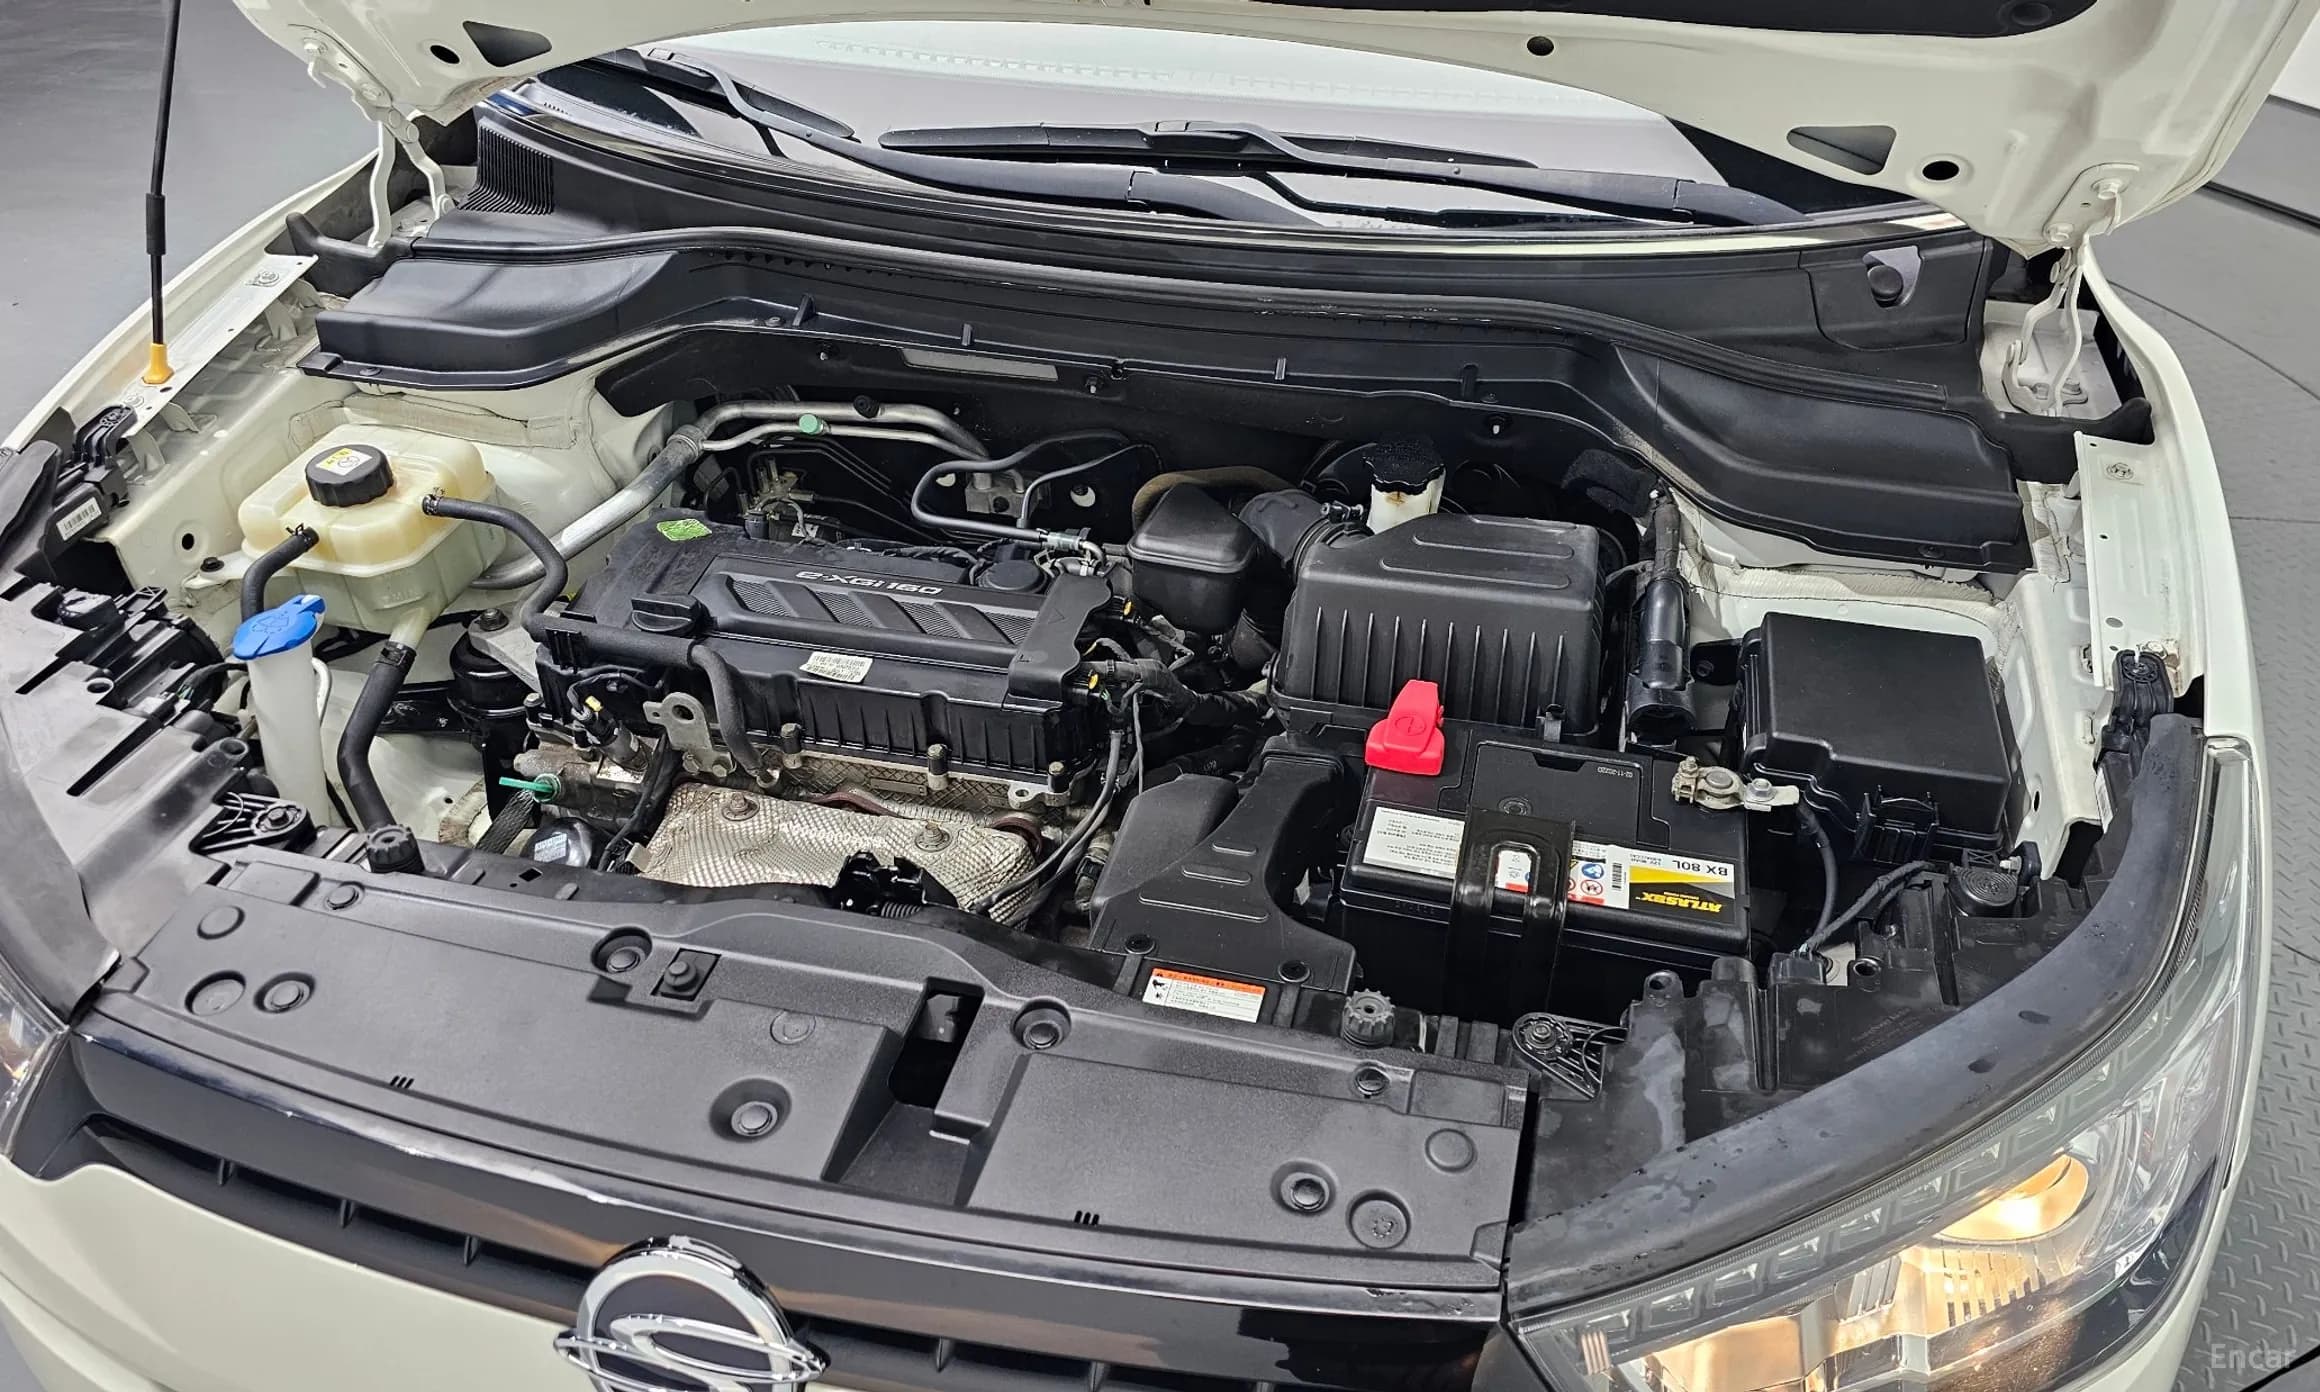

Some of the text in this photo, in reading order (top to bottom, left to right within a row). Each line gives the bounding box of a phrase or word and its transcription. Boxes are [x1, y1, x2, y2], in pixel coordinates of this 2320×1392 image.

[886, 582, 943, 595] 160
[1672, 859, 1728, 876] BX 80L
[1642, 891, 1723, 913] ATLASBX
